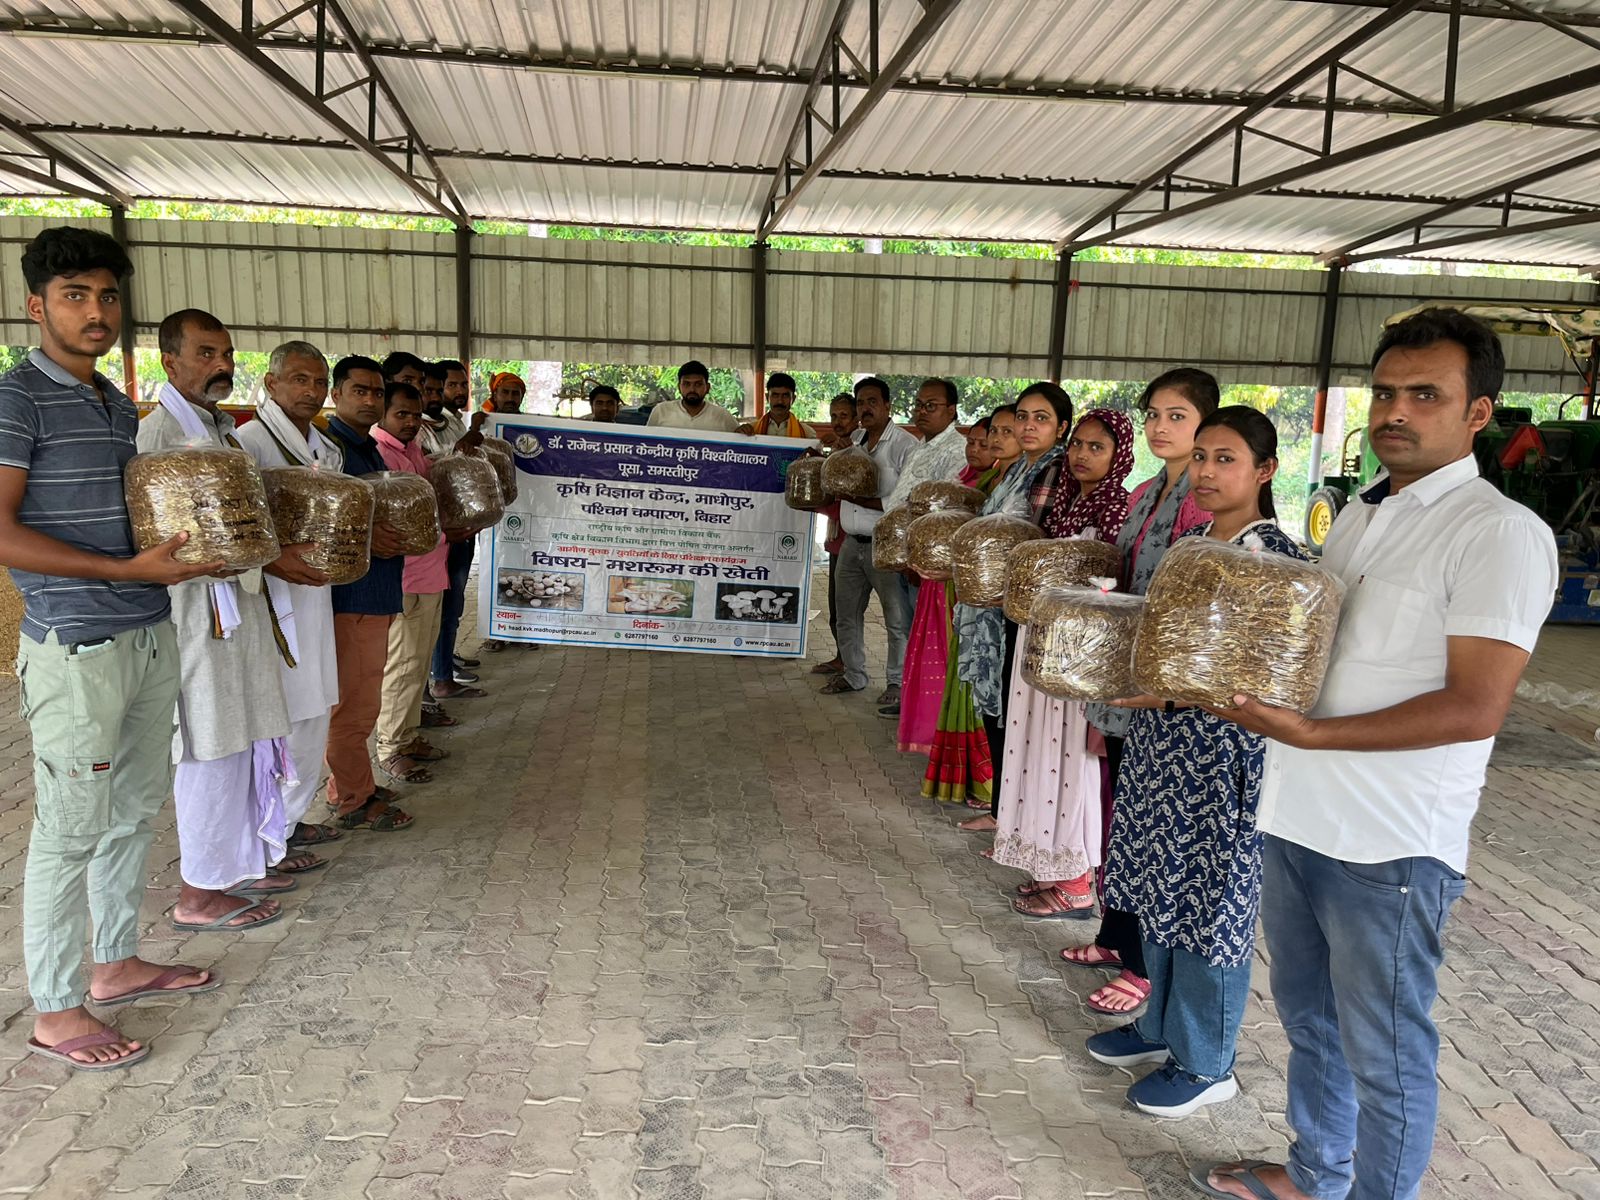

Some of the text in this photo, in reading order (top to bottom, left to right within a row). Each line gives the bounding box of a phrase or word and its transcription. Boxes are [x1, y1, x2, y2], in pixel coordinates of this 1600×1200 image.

[547, 435, 768, 465] डॉ. राजेन्द्र प्रसाद केन्द्रीय कृषि विश्वविद्यालय
[618, 462, 699, 481] पूसा, समस्तीपुर
[556, 481, 754, 510] कृषि विज्ञान केन्द्र, माधोपुर,
[581, 502, 732, 524] पश्चिम चम्पारण, बिहार
[605, 559, 685, 575] मशरूम
[688, 562, 719, 577] की
[722, 564, 770, 580] खेती
[745, 639, 791, 648] www.rpcau.ac.in
